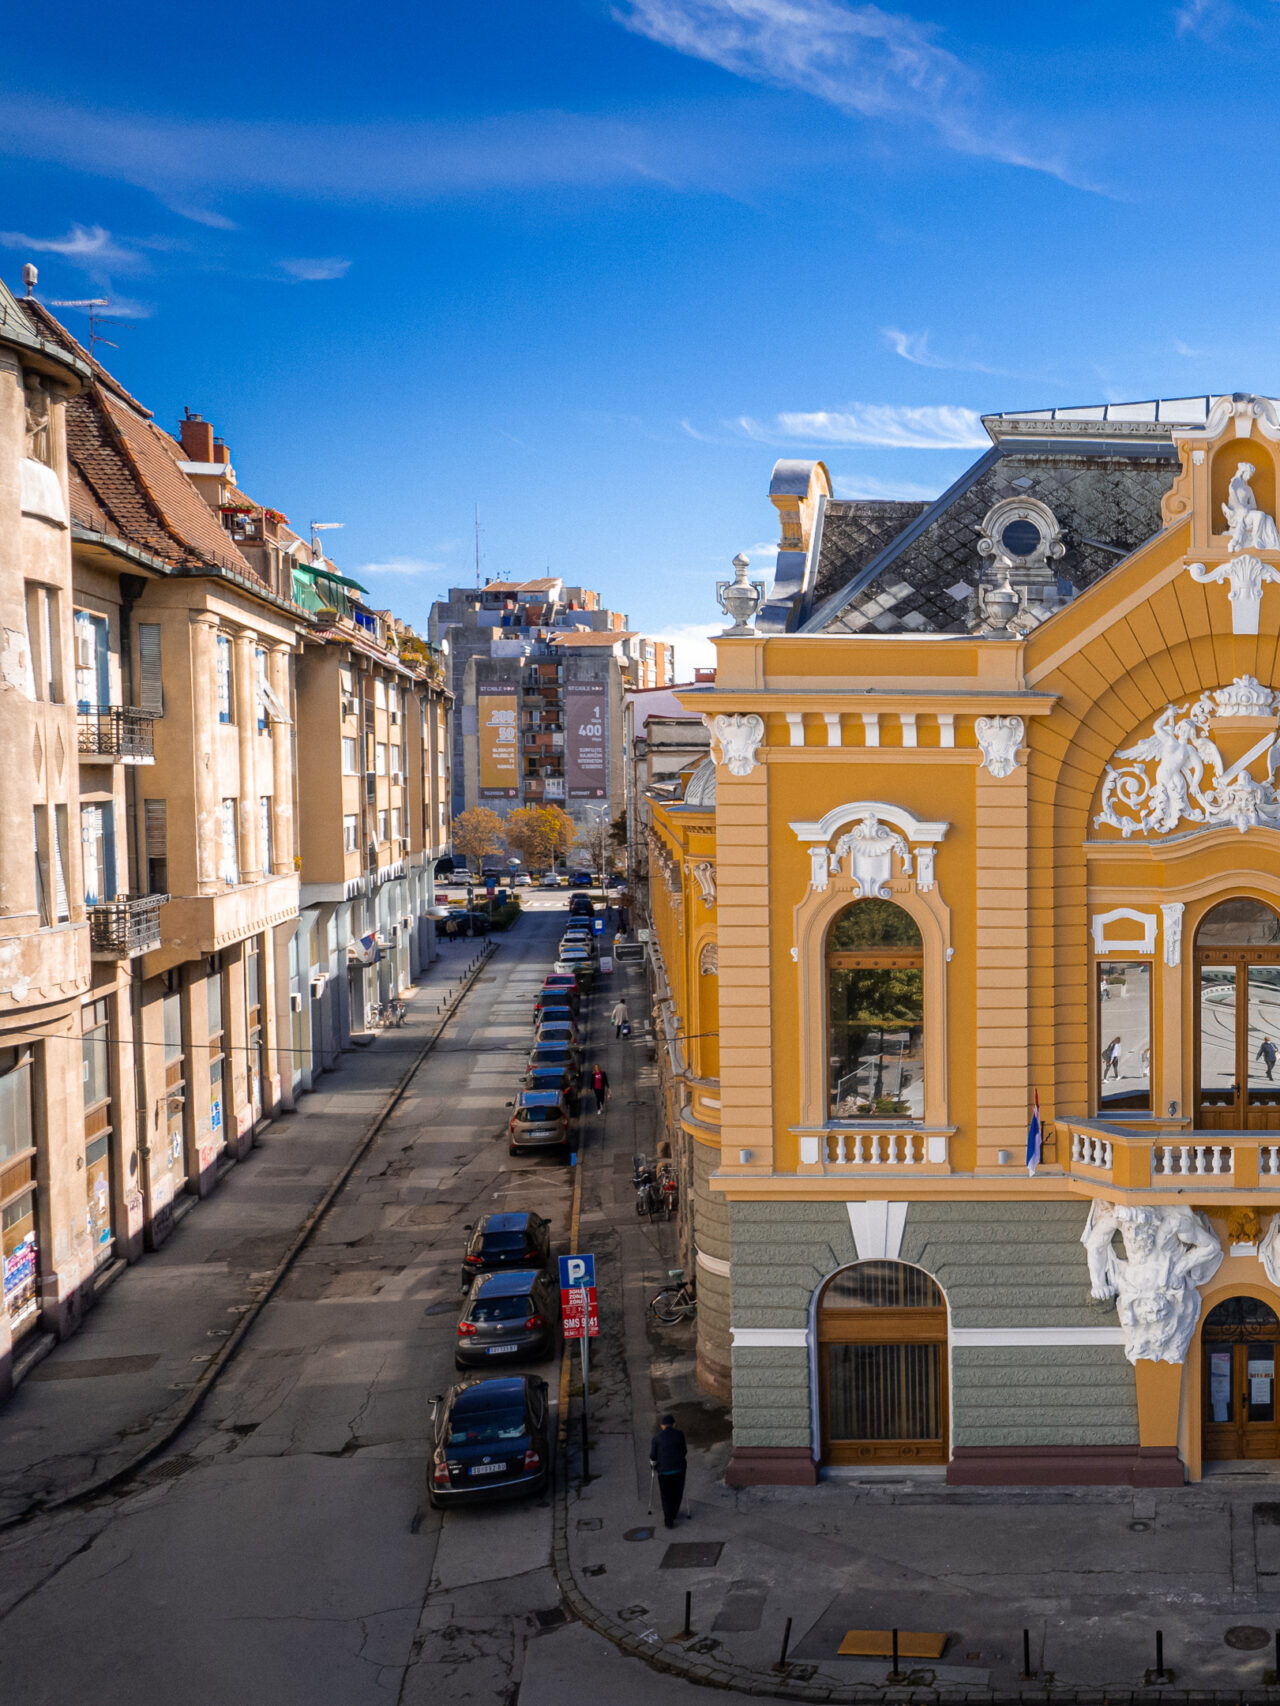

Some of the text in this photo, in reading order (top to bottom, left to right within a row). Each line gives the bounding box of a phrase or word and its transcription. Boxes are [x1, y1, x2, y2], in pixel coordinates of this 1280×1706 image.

[491, 710, 515, 722] 200
[593, 706, 600, 718] 1
[499, 727, 515, 739] 50
[578, 724, 602, 736] 400
[567, 1259, 586, 1285] P
[564, 1316, 598, 1328] SMS 941
